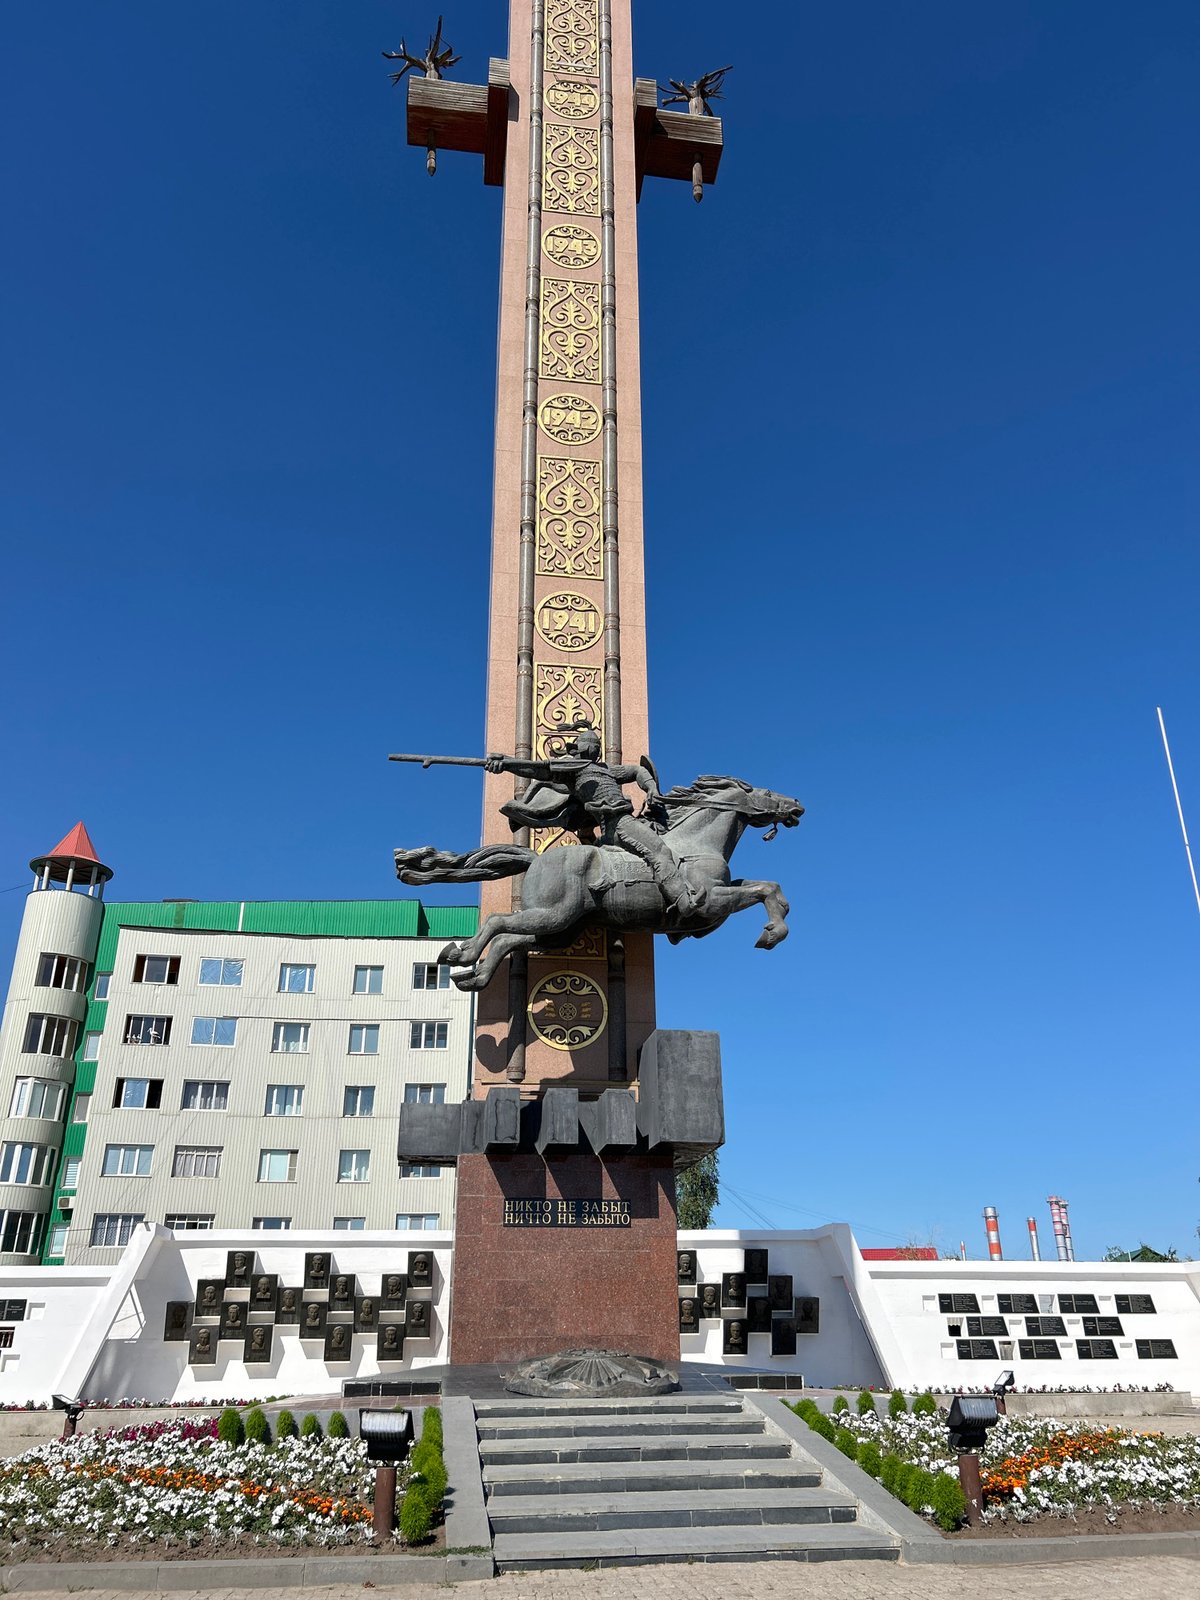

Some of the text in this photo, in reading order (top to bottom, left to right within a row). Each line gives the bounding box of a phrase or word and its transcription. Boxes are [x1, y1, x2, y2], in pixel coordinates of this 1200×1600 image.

[549, 90, 595, 109] 1944
[545, 235, 598, 257] 1943
[543, 407, 598, 431] 1942
[542, 608, 596, 634] 1941
[504, 1200, 631, 1213] НИКТО НЕ ЗАБЫТ
[504, 1212, 630, 1225] НИЧТО НЕ ЗАБЫТО
